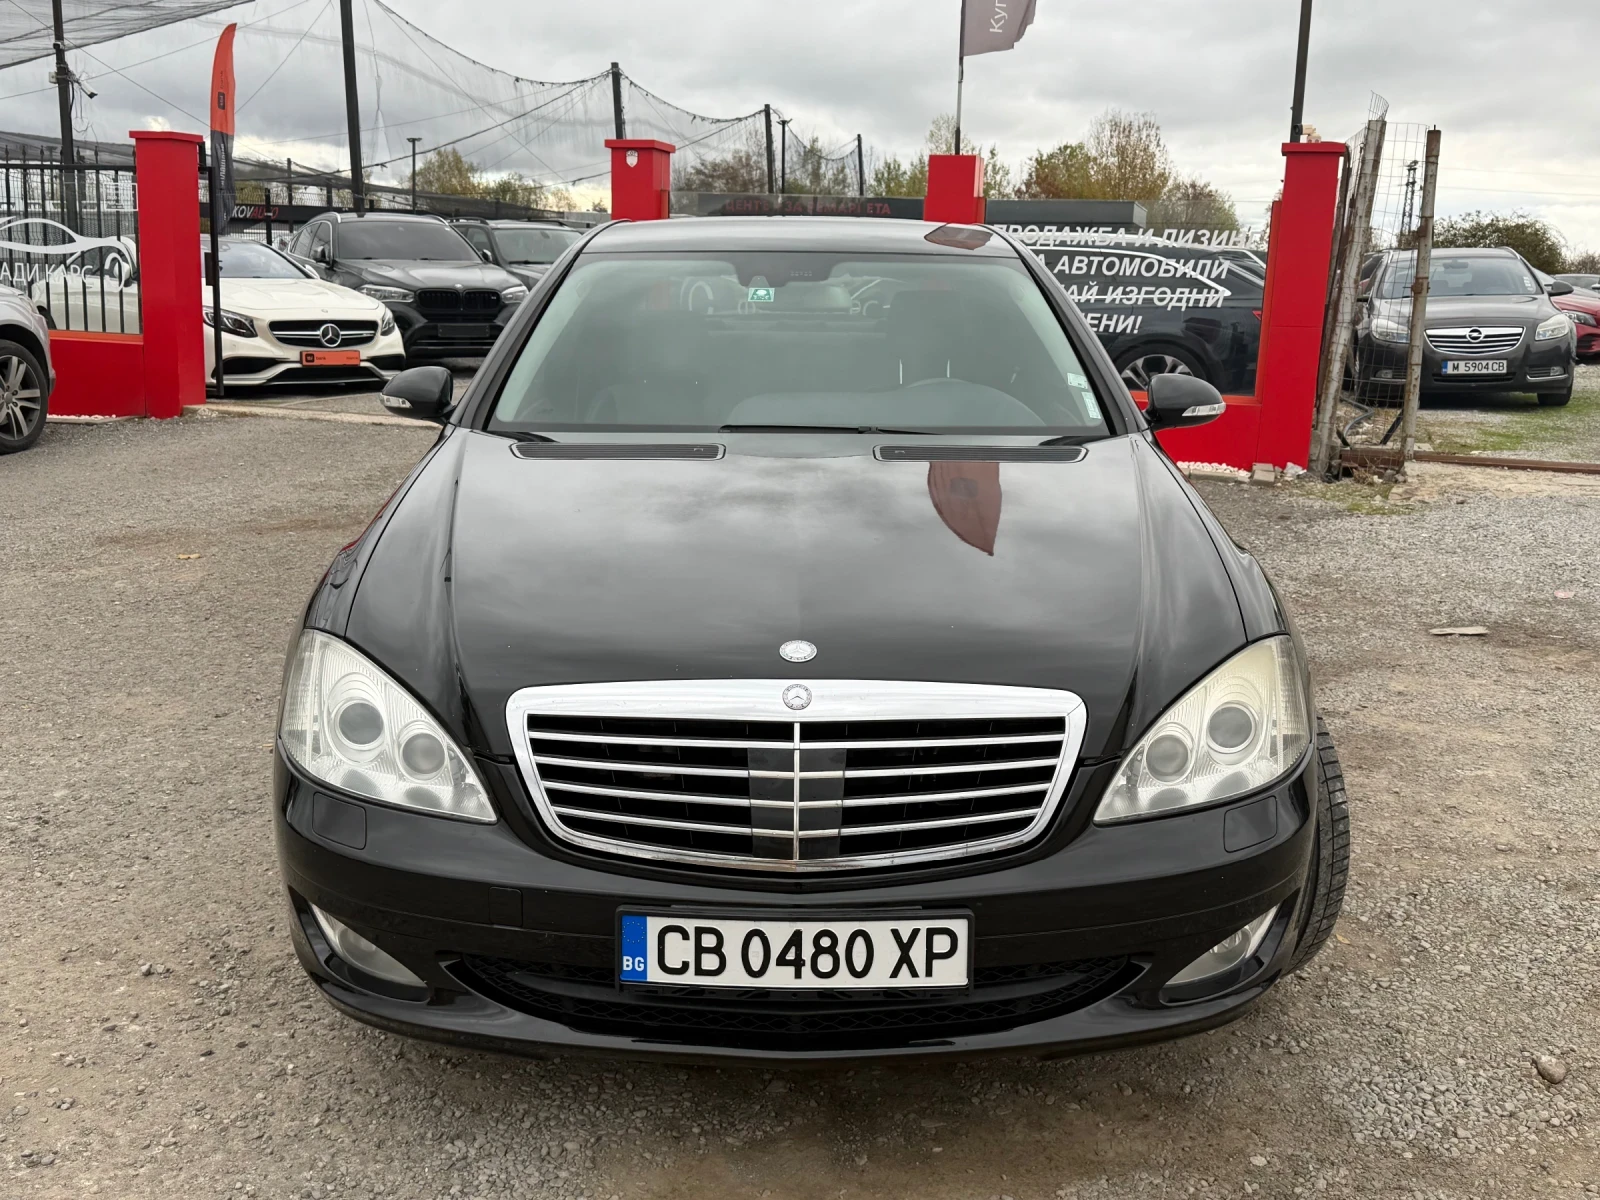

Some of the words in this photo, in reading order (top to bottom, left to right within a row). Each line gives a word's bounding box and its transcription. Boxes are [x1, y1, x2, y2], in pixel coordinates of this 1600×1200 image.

[1135, 229, 1158, 247] И
[1053, 255, 1230, 279] АВТОМОБИЛИ
[1105, 285, 1227, 311] ИЗГОДНИ
[1452, 363, 1459, 372] M
[1464, 362, 1489, 372] 5904
[657, 925, 727, 976] CB
[741, 928, 875, 979] 0480
[889, 927, 959, 978] XP
[622, 955, 645, 972] BG
